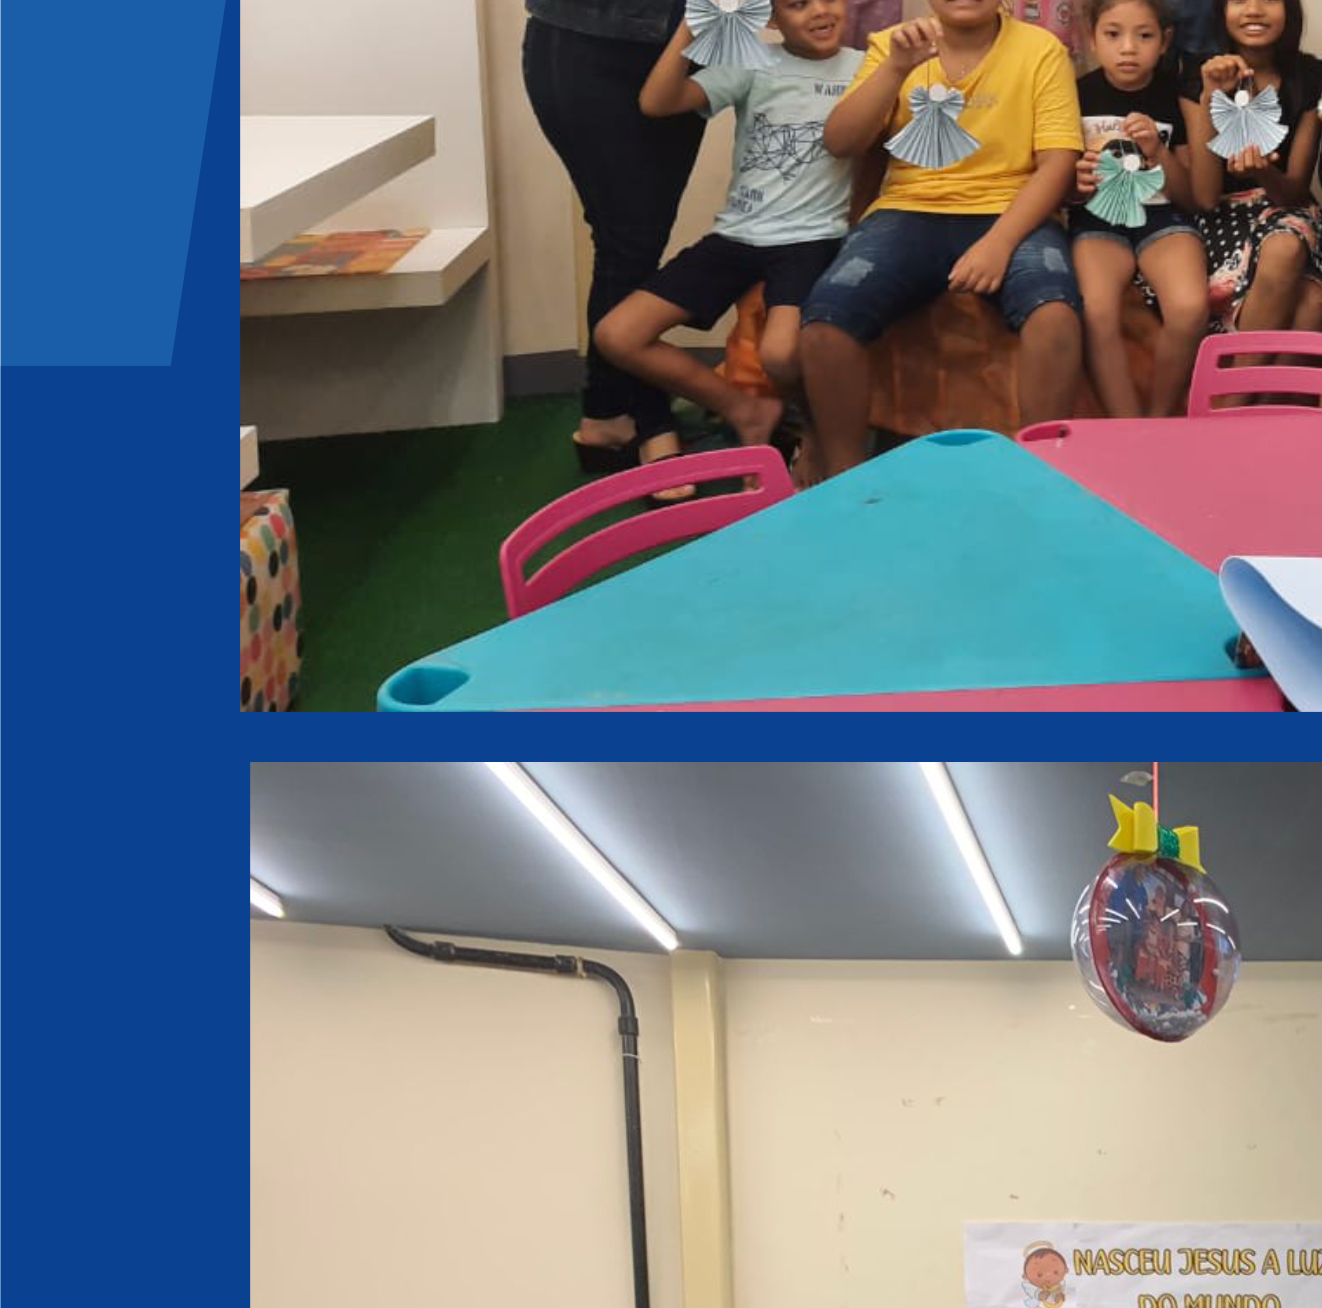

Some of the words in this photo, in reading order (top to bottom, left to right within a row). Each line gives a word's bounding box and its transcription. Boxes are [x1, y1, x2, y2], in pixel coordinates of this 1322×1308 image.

[1073, 1248, 1172, 1276] NASCEU
[1178, 1248, 1256, 1276] JESUS
[1261, 1249, 1280, 1276] A
